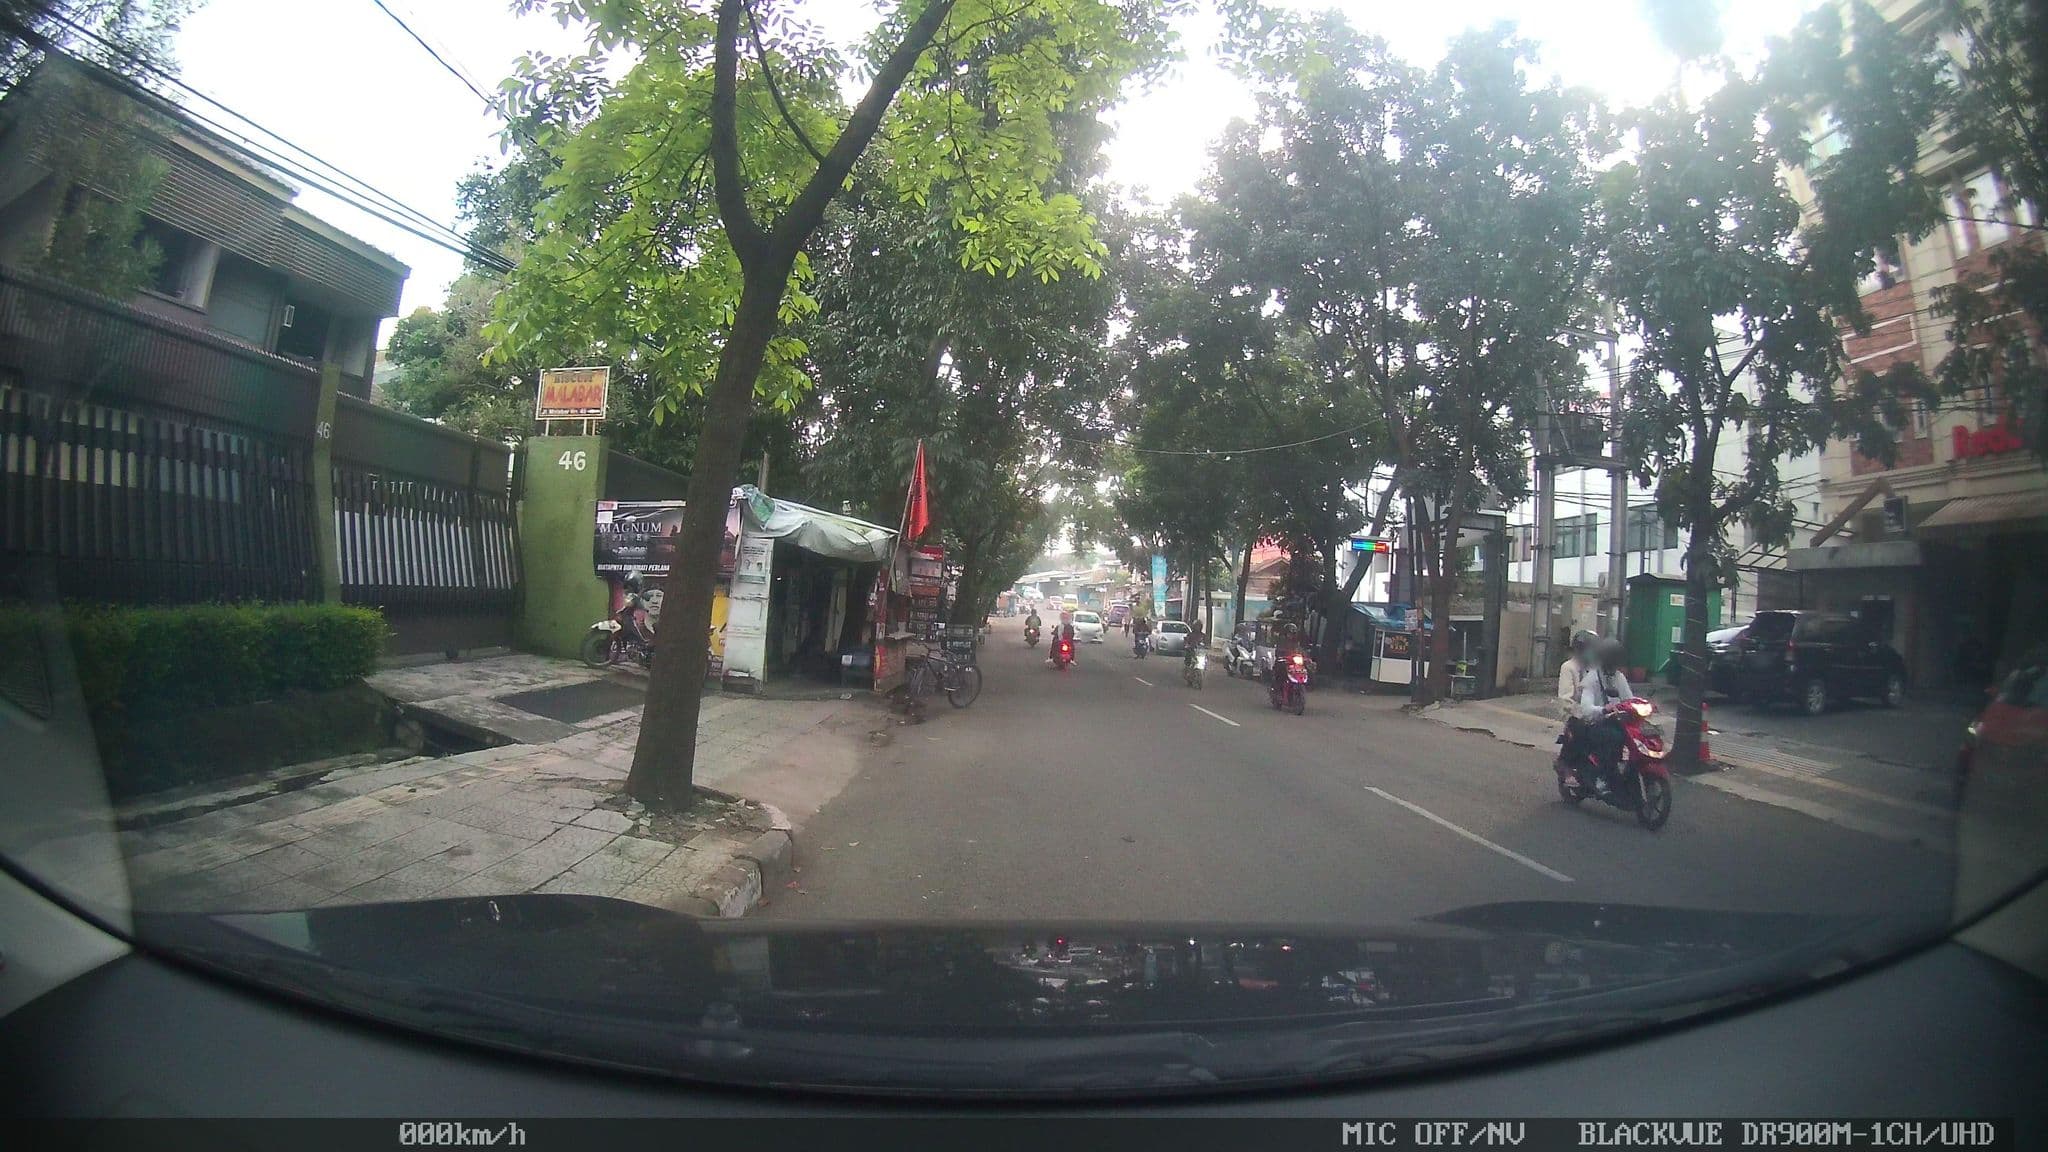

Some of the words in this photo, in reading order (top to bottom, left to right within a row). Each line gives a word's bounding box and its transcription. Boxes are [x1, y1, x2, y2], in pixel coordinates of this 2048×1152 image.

[544, 384, 602, 403] MALABAR
[316, 421, 331, 439] 46
[558, 450, 587, 471] 46
[599, 522, 662, 533] MAGNUM
